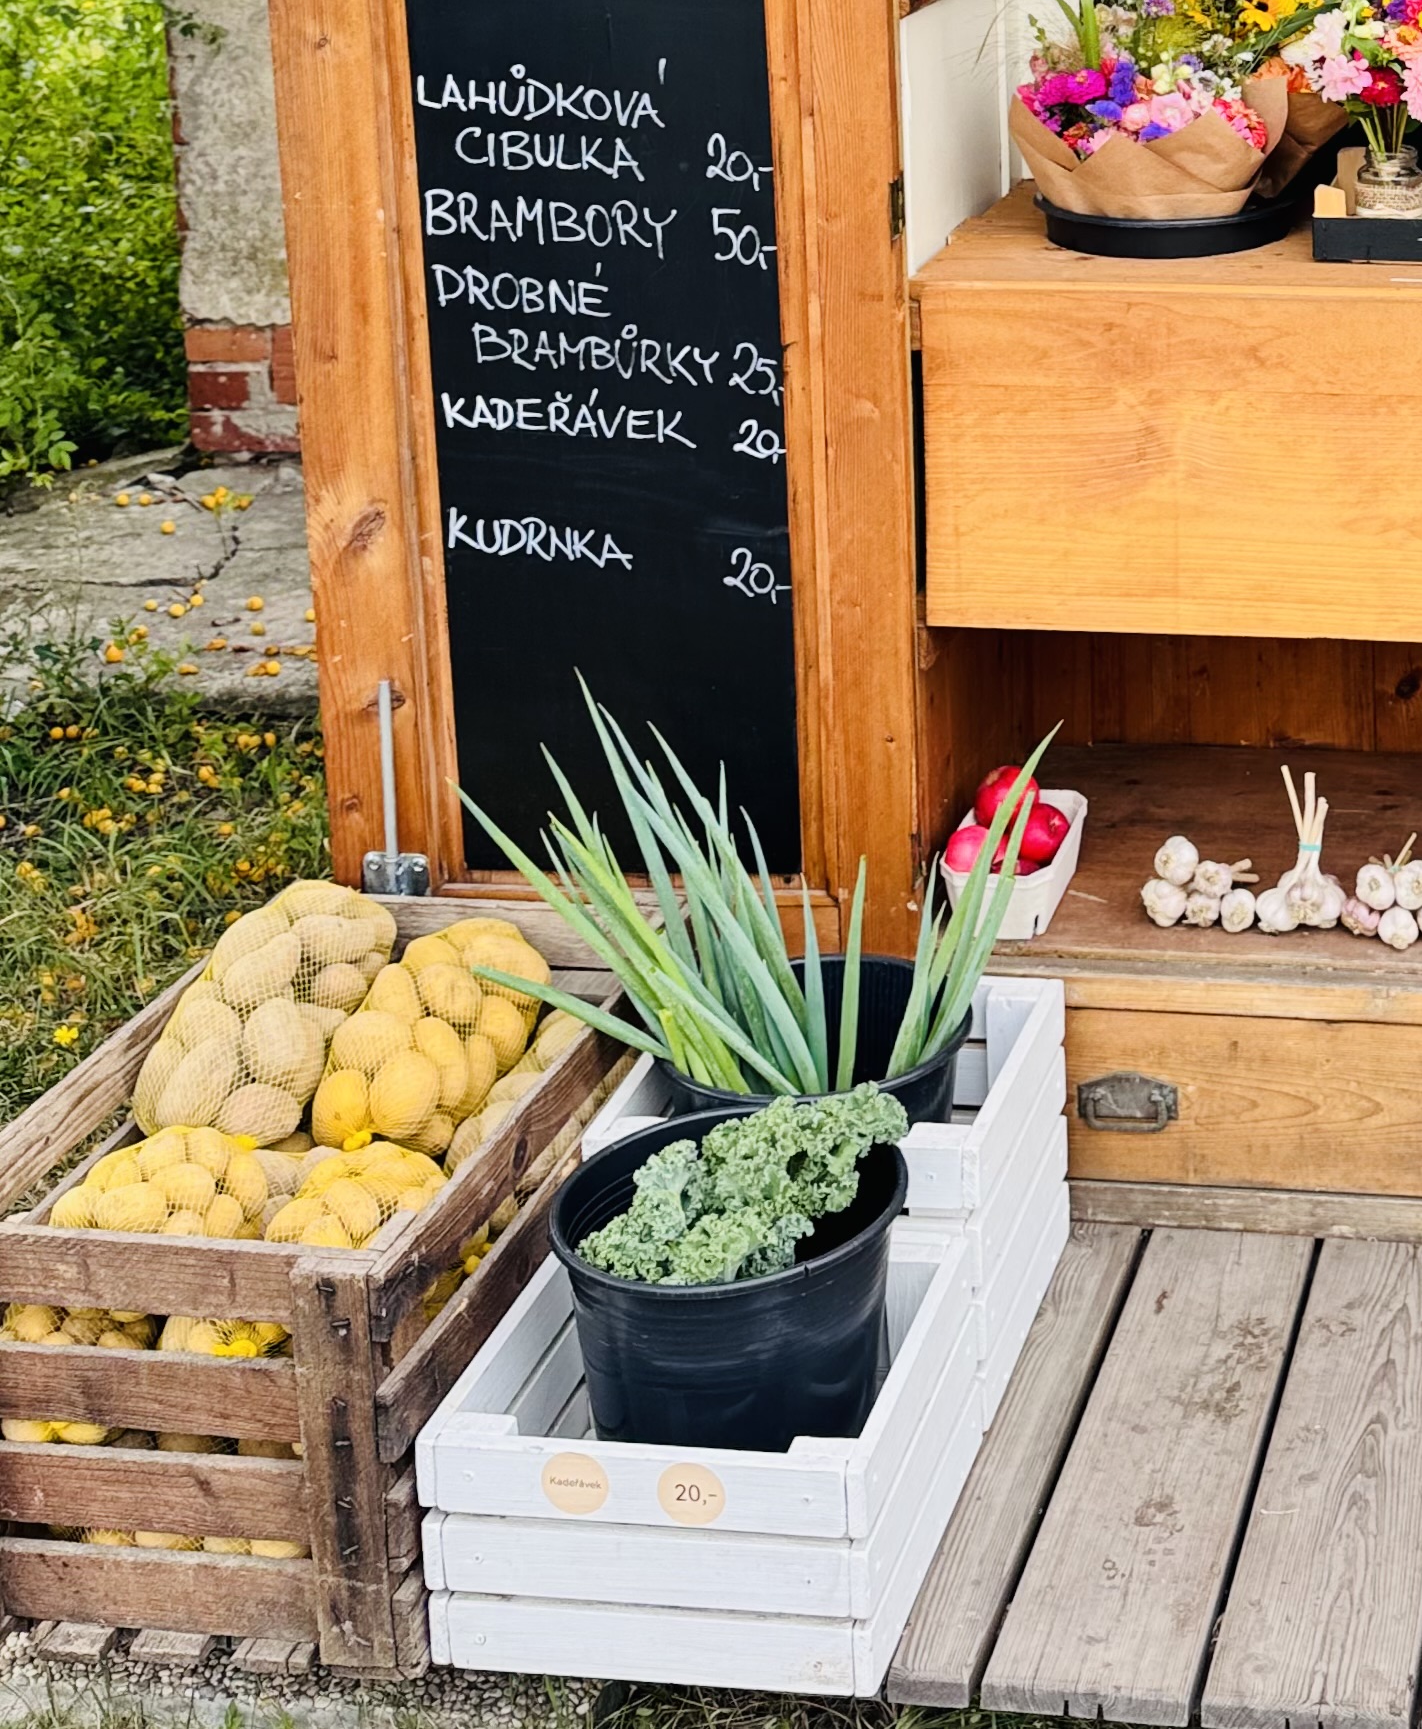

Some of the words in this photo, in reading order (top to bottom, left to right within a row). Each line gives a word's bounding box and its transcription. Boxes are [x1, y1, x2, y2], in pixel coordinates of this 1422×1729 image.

[417, 58, 666, 128] LAHŮDKOVÁ
[455, 127, 644, 181] CIBULKA
[425, 189, 677, 258] BRAMBORY
[431, 263, 610, 317] DROBNÉ
[472, 323, 719, 386] BRAMBŮRKY
[441, 388, 696, 448] KADEŘÁVEK
[448, 507, 633, 570] KUDRNKA
[548, 1474, 602, 1490] Kadeřávek
[673, 1481, 718, 1506] 20,-
